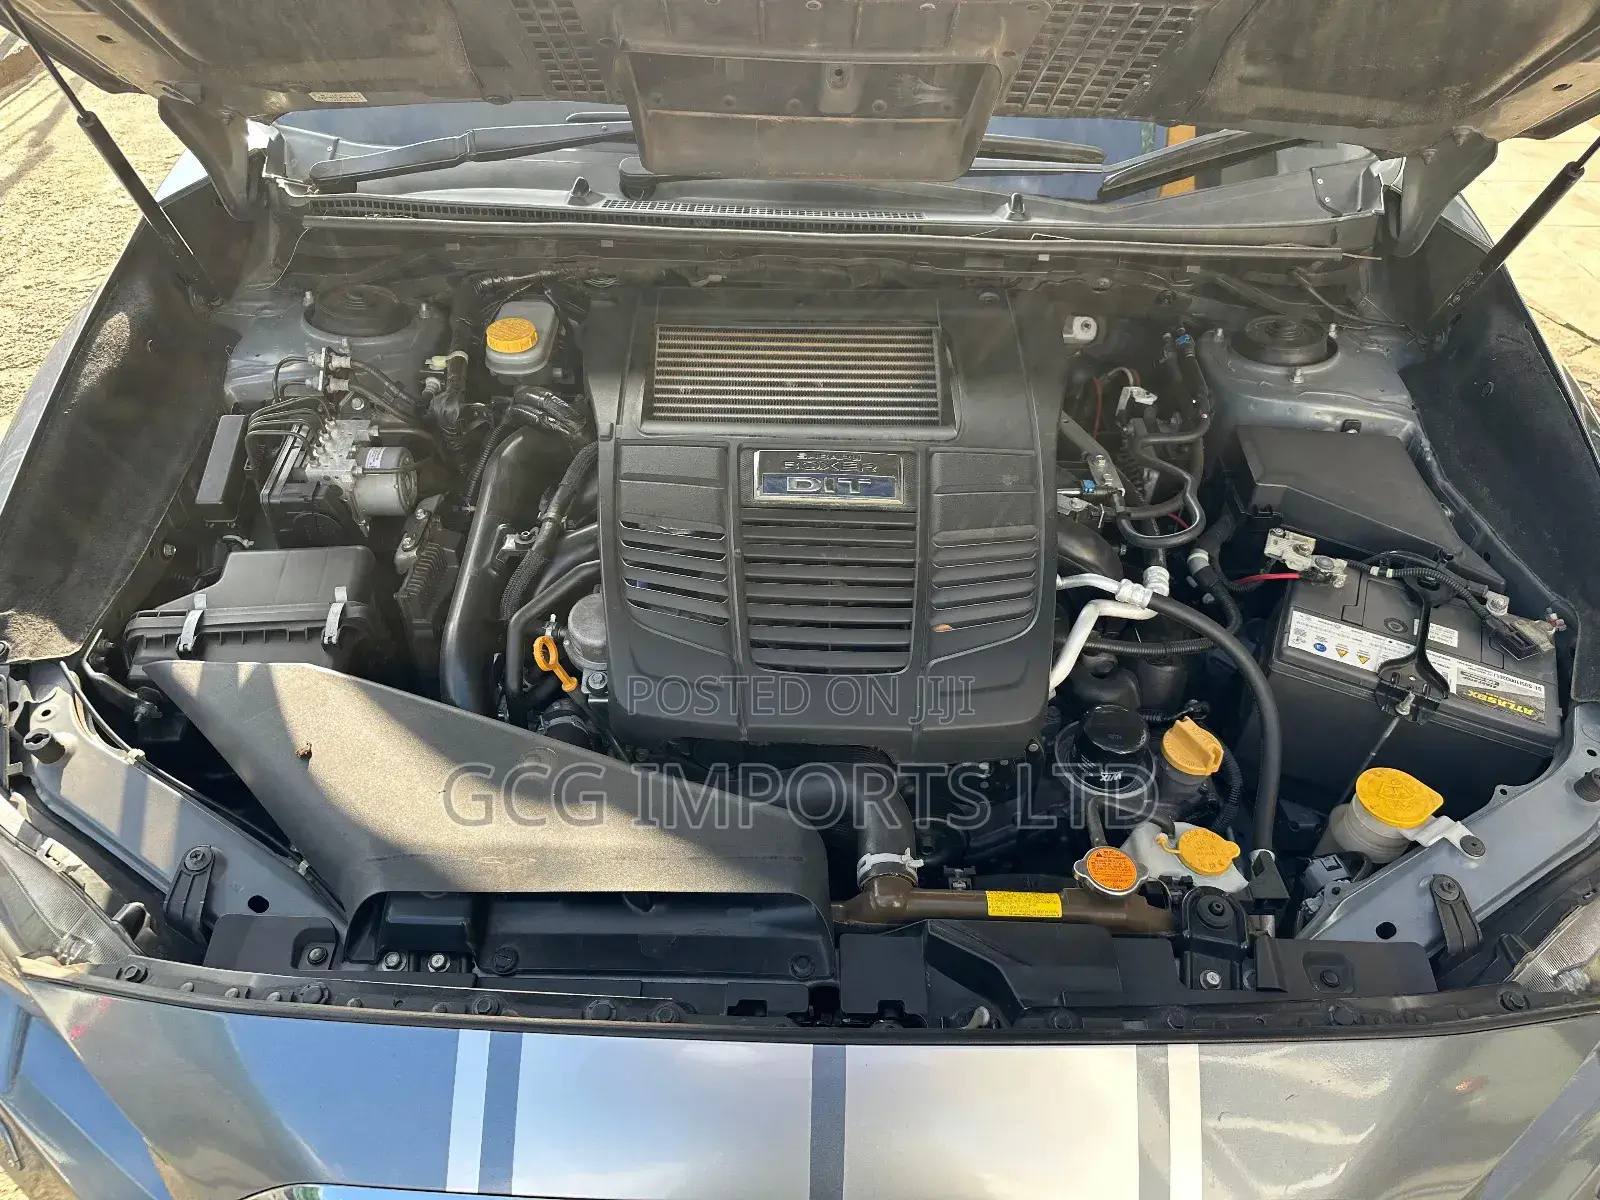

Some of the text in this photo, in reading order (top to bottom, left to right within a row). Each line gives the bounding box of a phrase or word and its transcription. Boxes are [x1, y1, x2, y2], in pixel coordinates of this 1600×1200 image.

[784, 461, 878, 473] BOXER
[786, 476, 872, 493] DIT
[1467, 690, 1535, 716] ATLASBX
[1100, 771, 1123, 782] WIX
